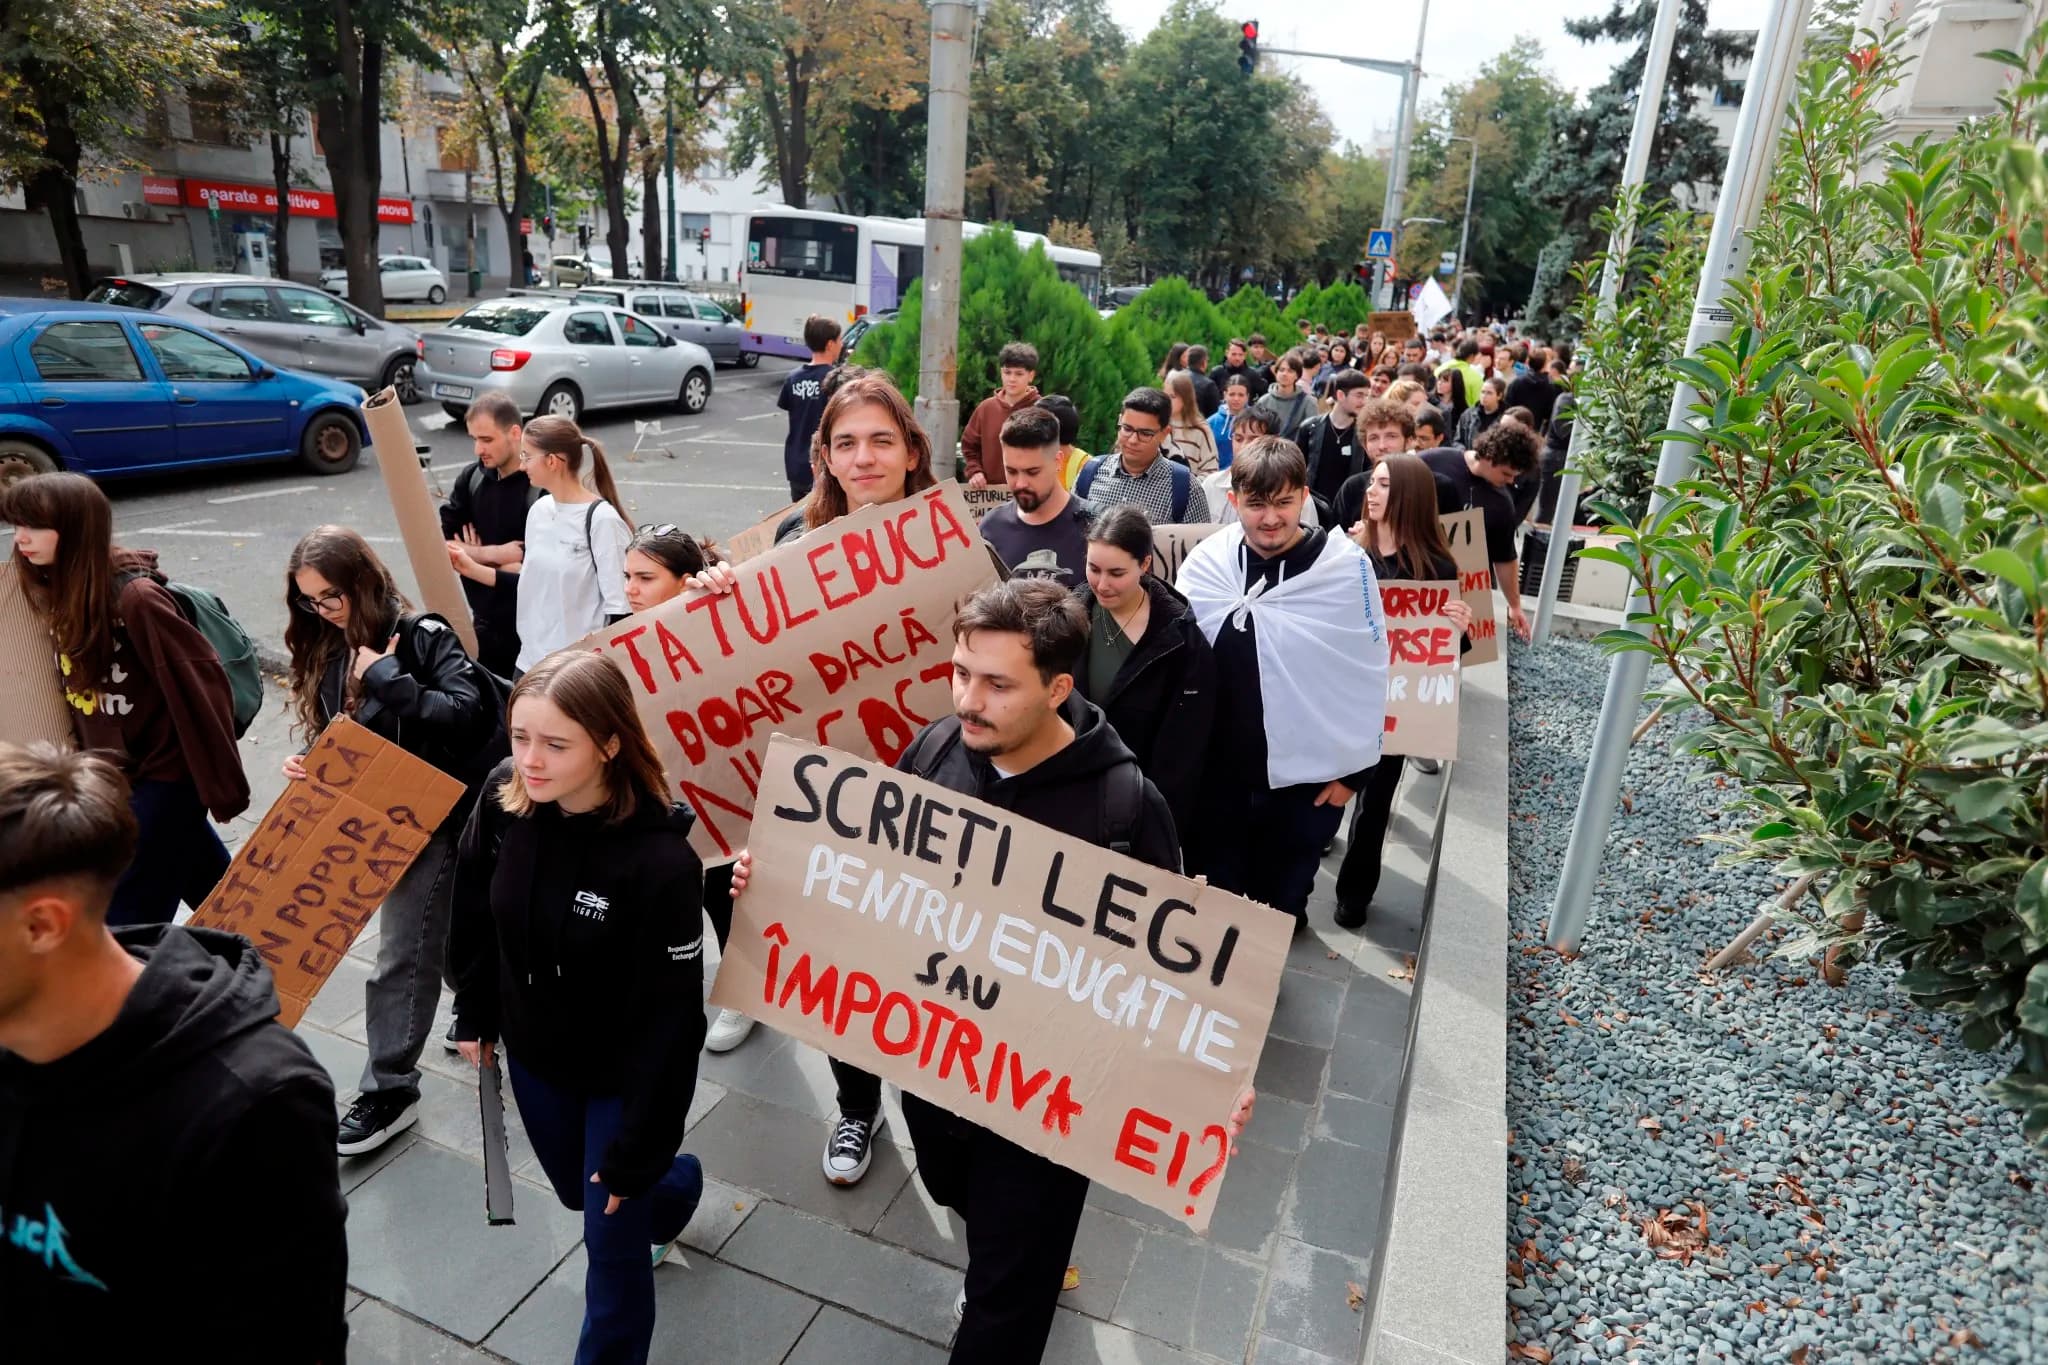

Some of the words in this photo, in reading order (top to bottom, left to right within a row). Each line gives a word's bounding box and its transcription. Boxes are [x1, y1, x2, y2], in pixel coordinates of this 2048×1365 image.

[807, 489, 971, 611] EDUCĂ
[665, 670, 802, 766] DOAR
[809, 608, 939, 695] DACĂ
[1417, 673, 1454, 706] UN
[276, 817, 378, 928] POPOR
[802, 843, 982, 953] PENTRU
[1042, 851, 1240, 987] LEGI
[914, 951, 1001, 1010] SAU
